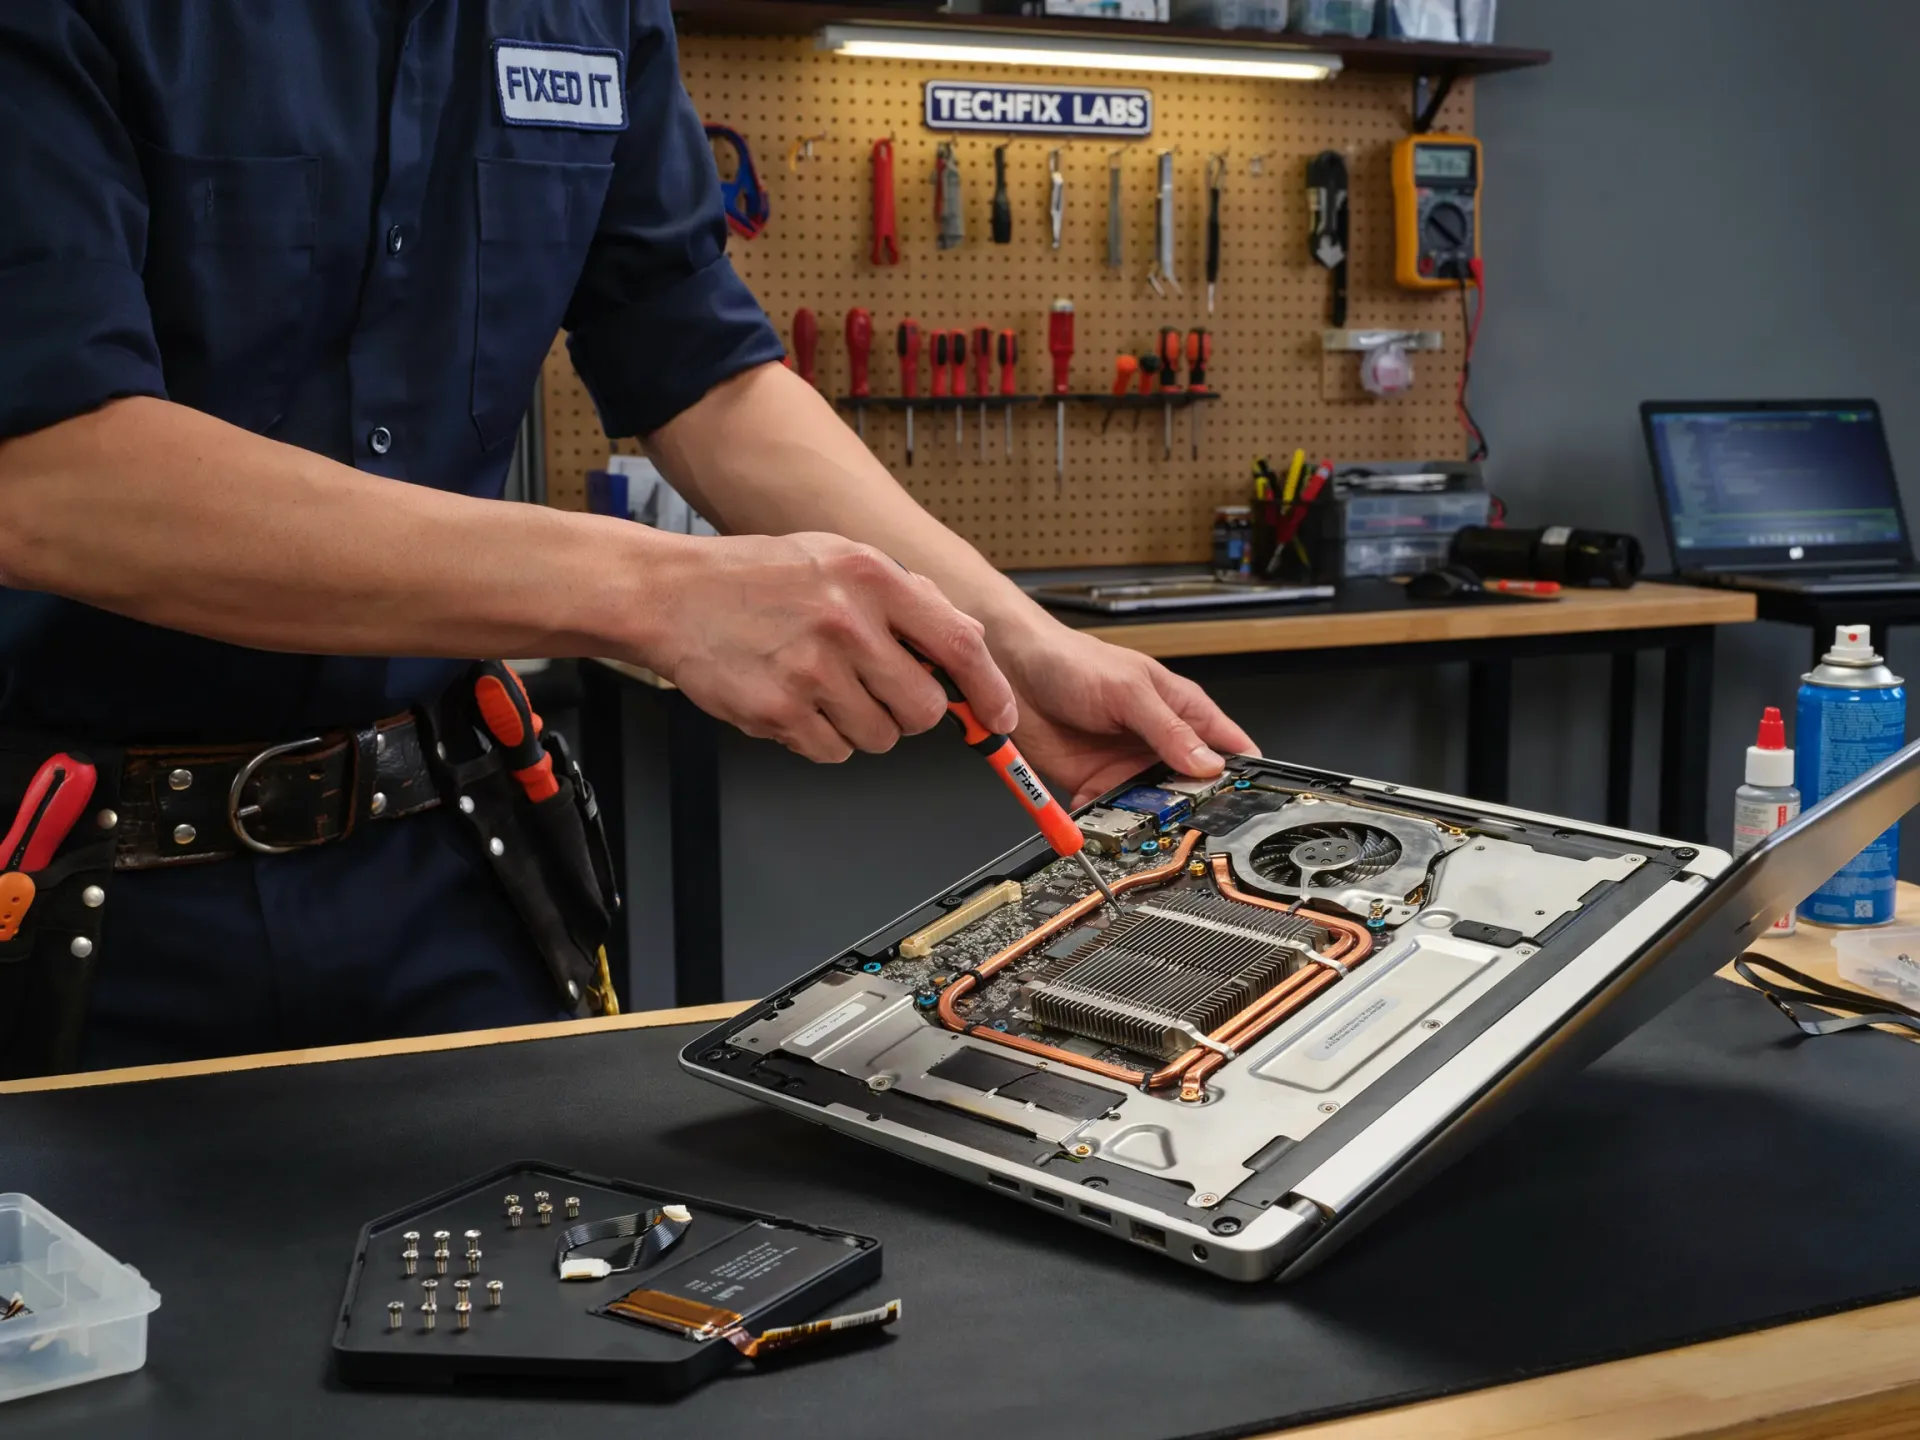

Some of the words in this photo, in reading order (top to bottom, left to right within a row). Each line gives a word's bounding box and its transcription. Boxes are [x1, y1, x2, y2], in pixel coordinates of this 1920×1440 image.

[506, 65, 582, 105] FIXED
[588, 73, 612, 108] IT
[934, 89, 1063, 123] TECHFIX
[1072, 95, 1145, 126] LABS
